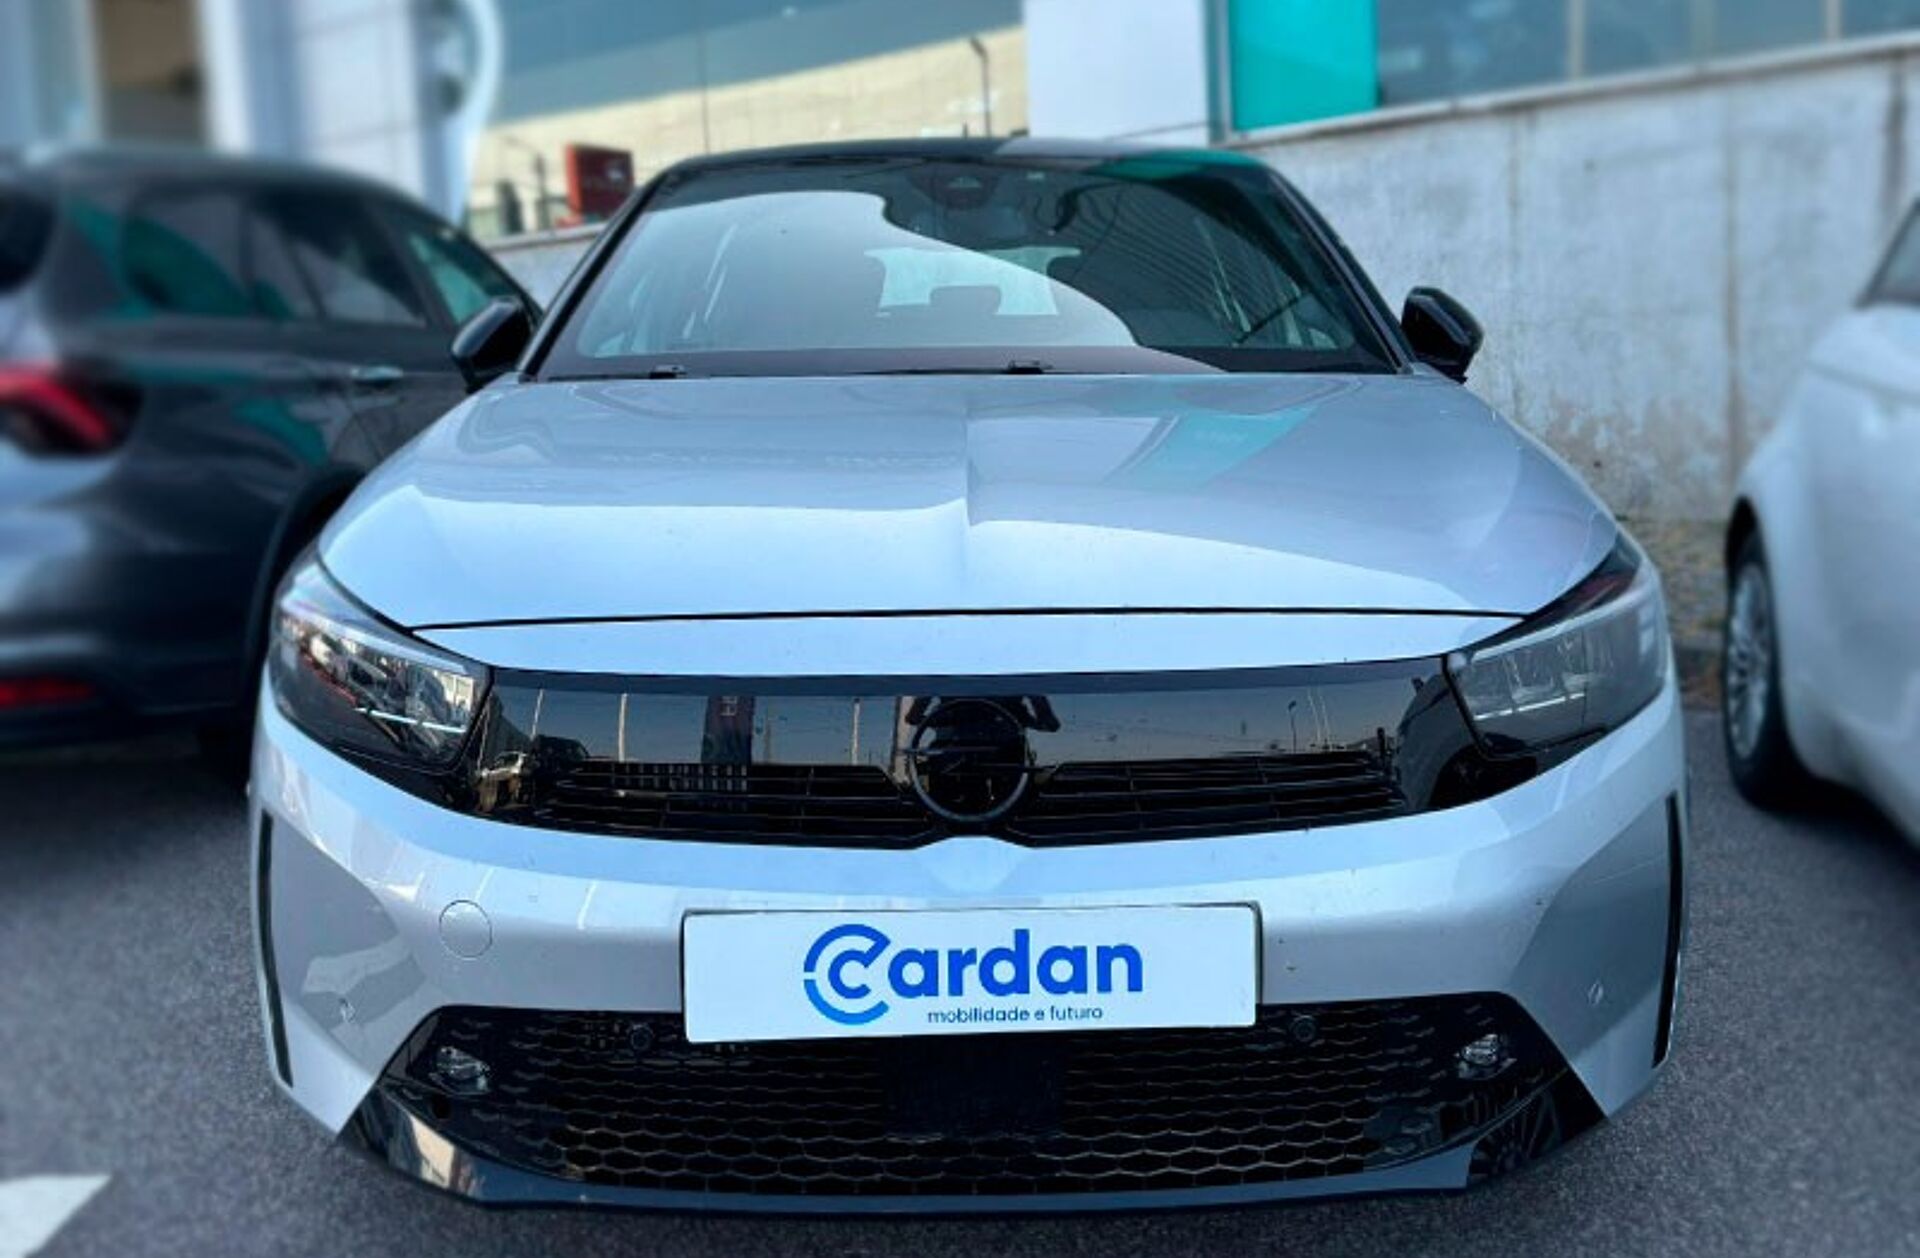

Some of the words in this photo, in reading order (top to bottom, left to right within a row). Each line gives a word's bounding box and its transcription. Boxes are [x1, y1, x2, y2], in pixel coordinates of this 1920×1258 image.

[804, 924, 1143, 1026] Cardan
[928, 1006, 1030, 1023] mobilidade
[1034, 1009, 1045, 1021] e
[1050, 1005, 1103, 1021] futuro
